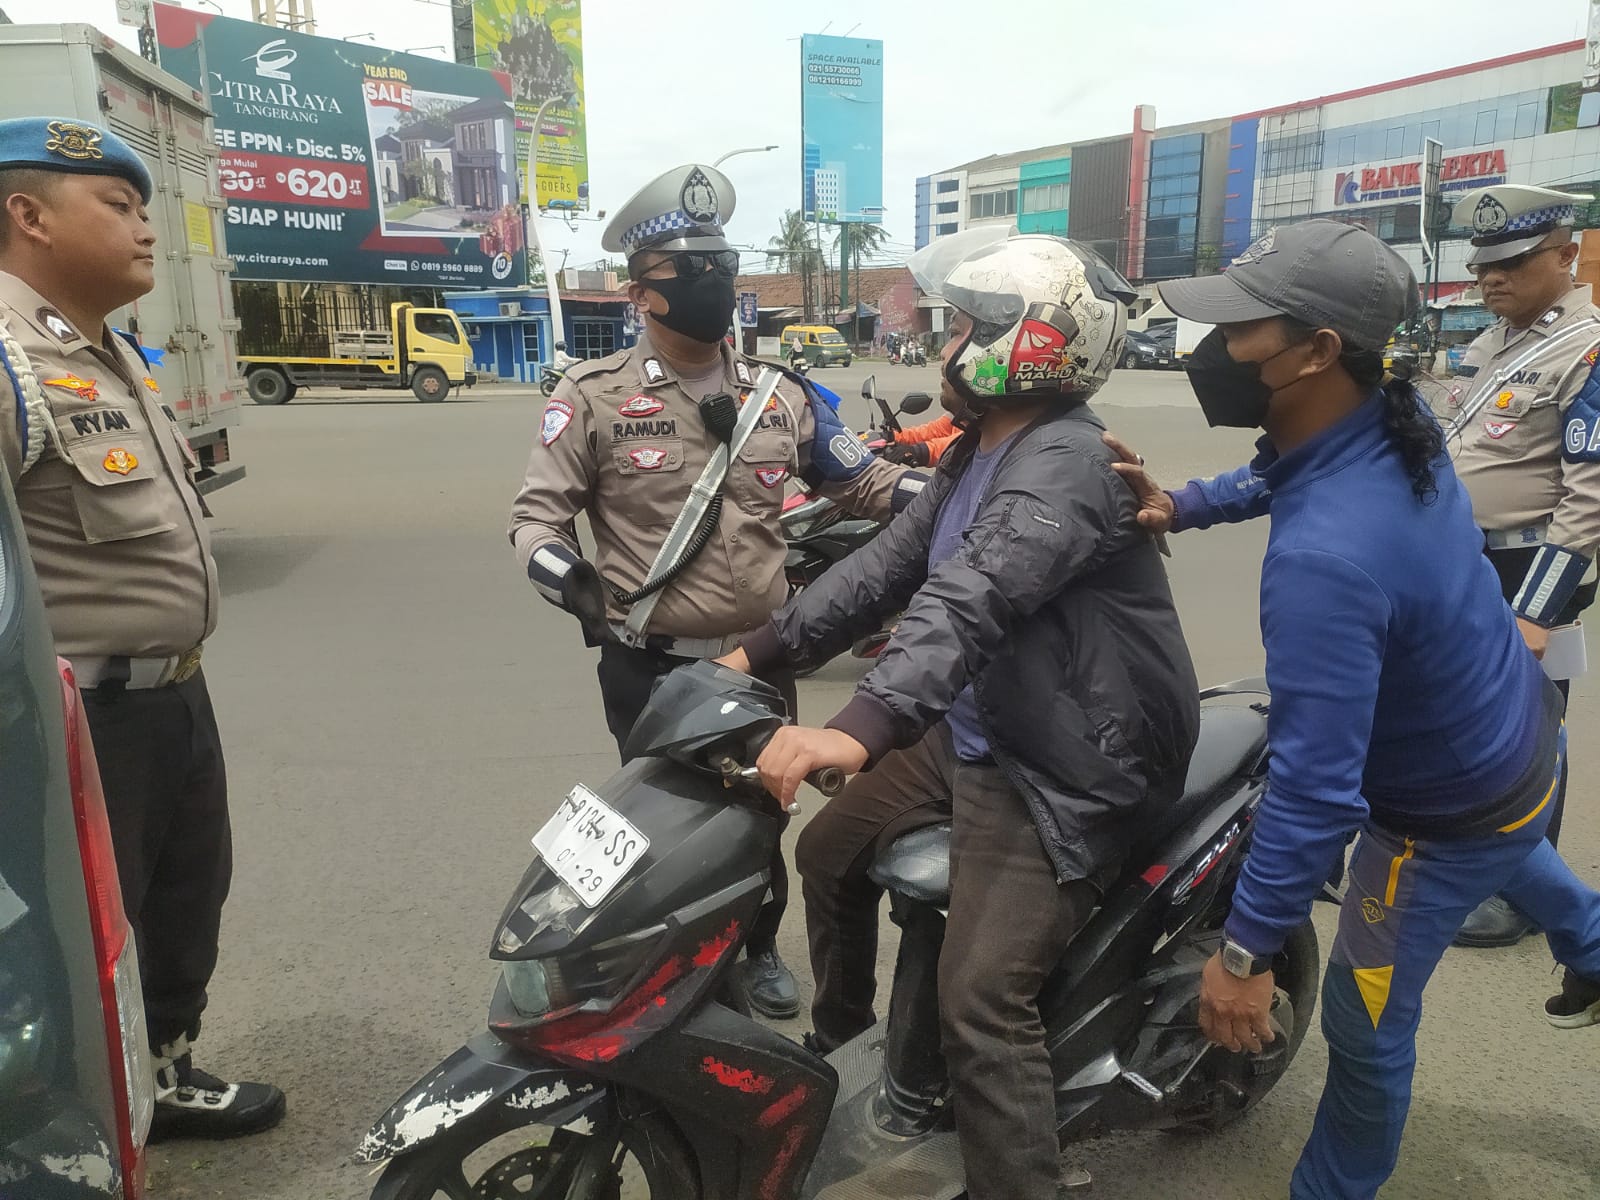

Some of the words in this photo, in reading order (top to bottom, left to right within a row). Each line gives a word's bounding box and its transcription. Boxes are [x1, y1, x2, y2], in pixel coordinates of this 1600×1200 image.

[808, 54, 834, 62] SPACE
[835, 56, 881, 66] AVAILABLE
[808, 63, 822, 73] 021
[362, 62, 388, 78] YEAR
[388, 67, 408, 82] END
[365, 82, 412, 106] SALE
[233, 102, 319, 124] TANGERANG
[520, 119, 559, 132] TANRANG
[214, 128, 237, 148] EE
[240, 131, 283, 153] PPN
[296, 138, 338, 159] Disc.
[340, 143, 367, 162] 5%
[233, 158, 258, 169] Mulai
[218, 169, 254, 192] 30
[287, 168, 348, 200] 620
[349, 179, 361, 190] JT
[1360, 162, 1423, 191] BANK
[541, 180, 572, 194] GOERS
[227, 206, 278, 227] SIAP
[421, 262, 441, 271] 0819
[442, 263, 462, 272] 5960
[1017, 361, 1049, 373] DJ
[1510, 369, 1542, 385] OLRI
[70, 410, 131, 436] RYAN
[613, 419, 677, 438] RAMUDI
[755, 413, 789, 430] LRI
[603, 829, 636, 867] SS
